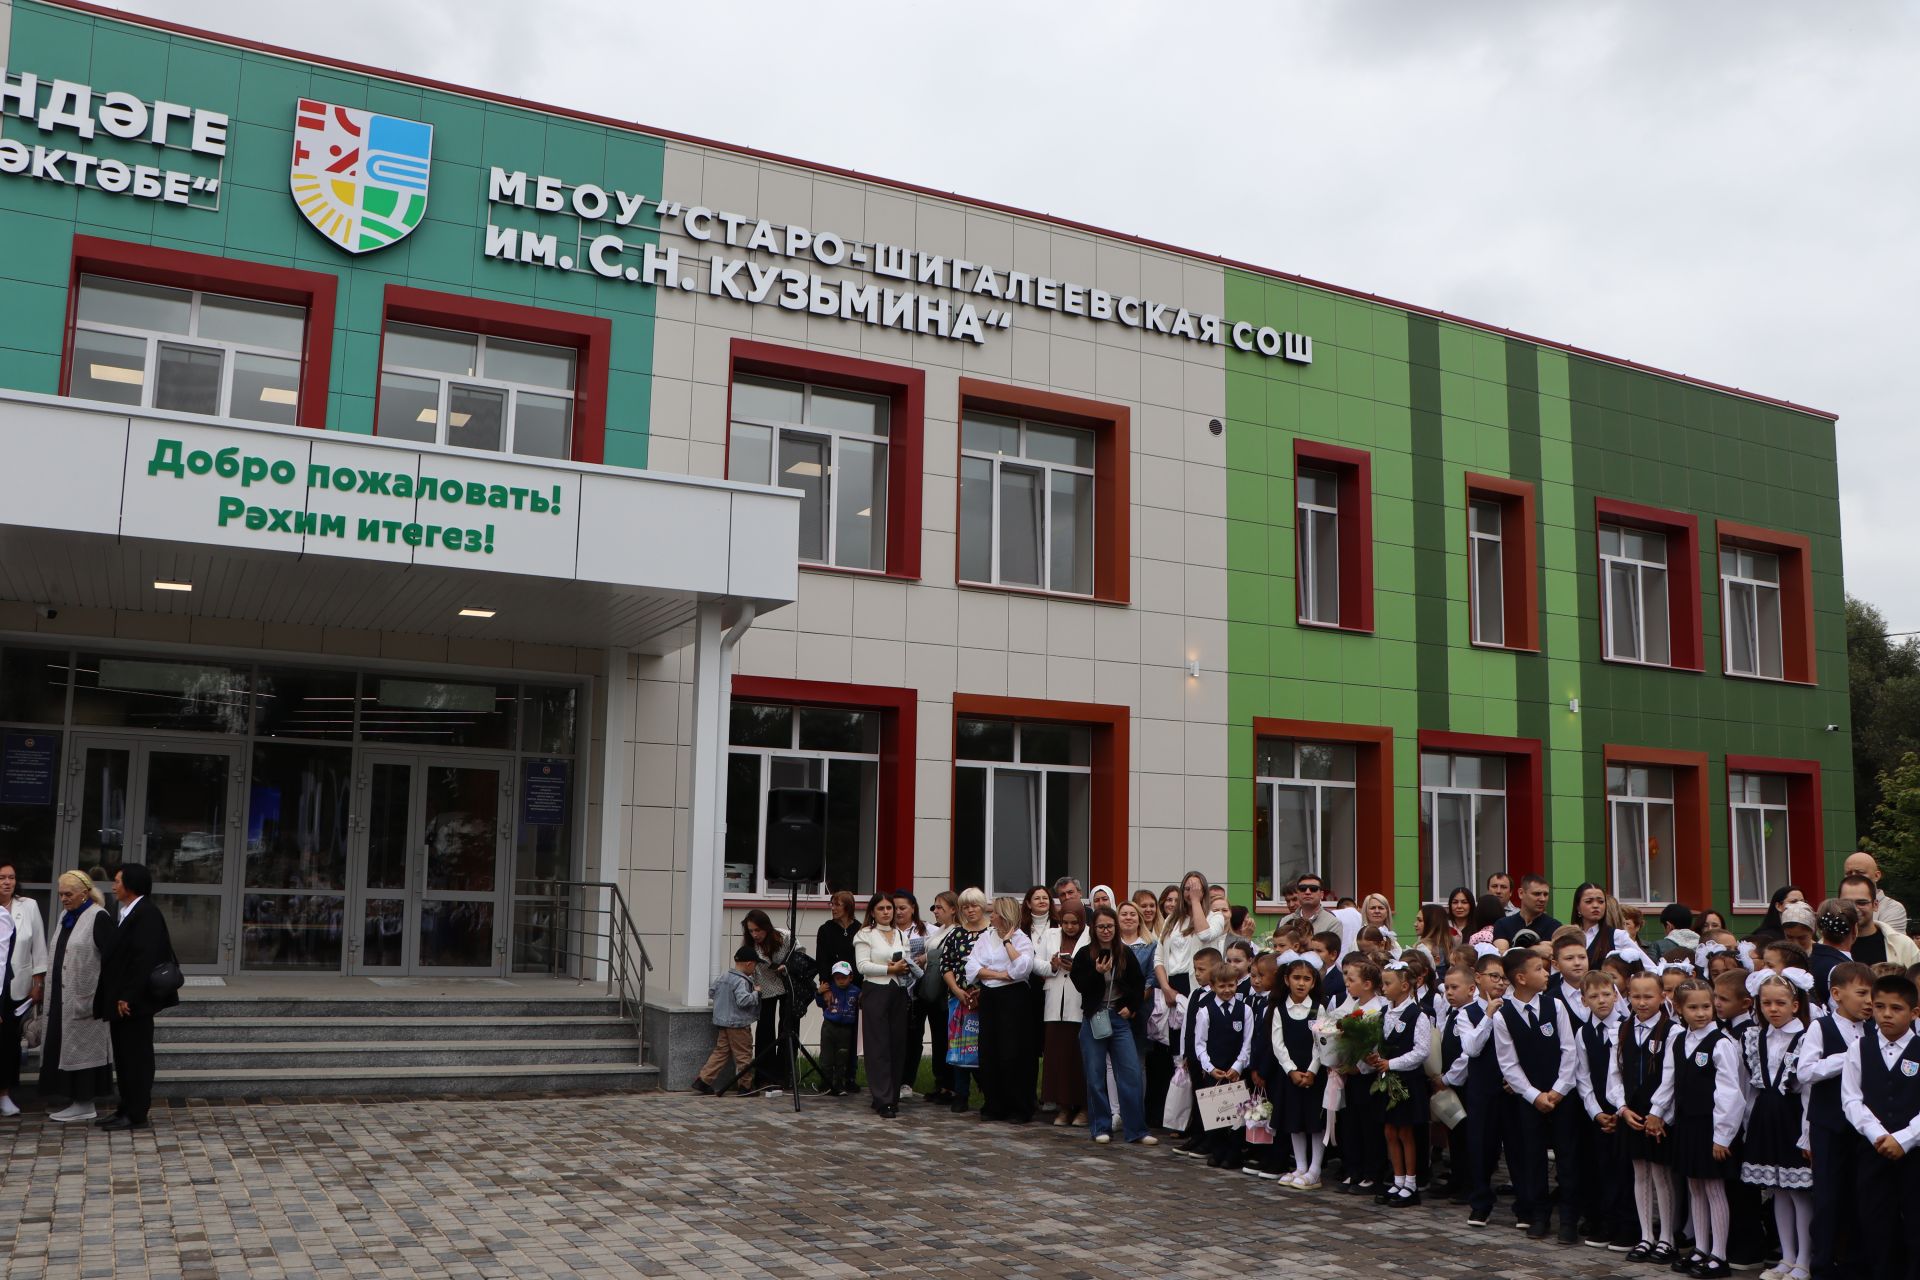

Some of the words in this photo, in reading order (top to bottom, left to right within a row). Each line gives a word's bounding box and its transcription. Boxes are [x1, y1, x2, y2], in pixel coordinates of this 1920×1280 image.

[488, 166, 645, 226] МБОУ
[1232, 321, 1313, 364] СОШ
[588, 234, 695, 291] С.Н.
[148, 438, 296, 488] Добро
[308, 463, 561, 515] пожаловать!
[218, 495, 346, 539] Рәхим
[357, 518, 495, 554] итегез!
